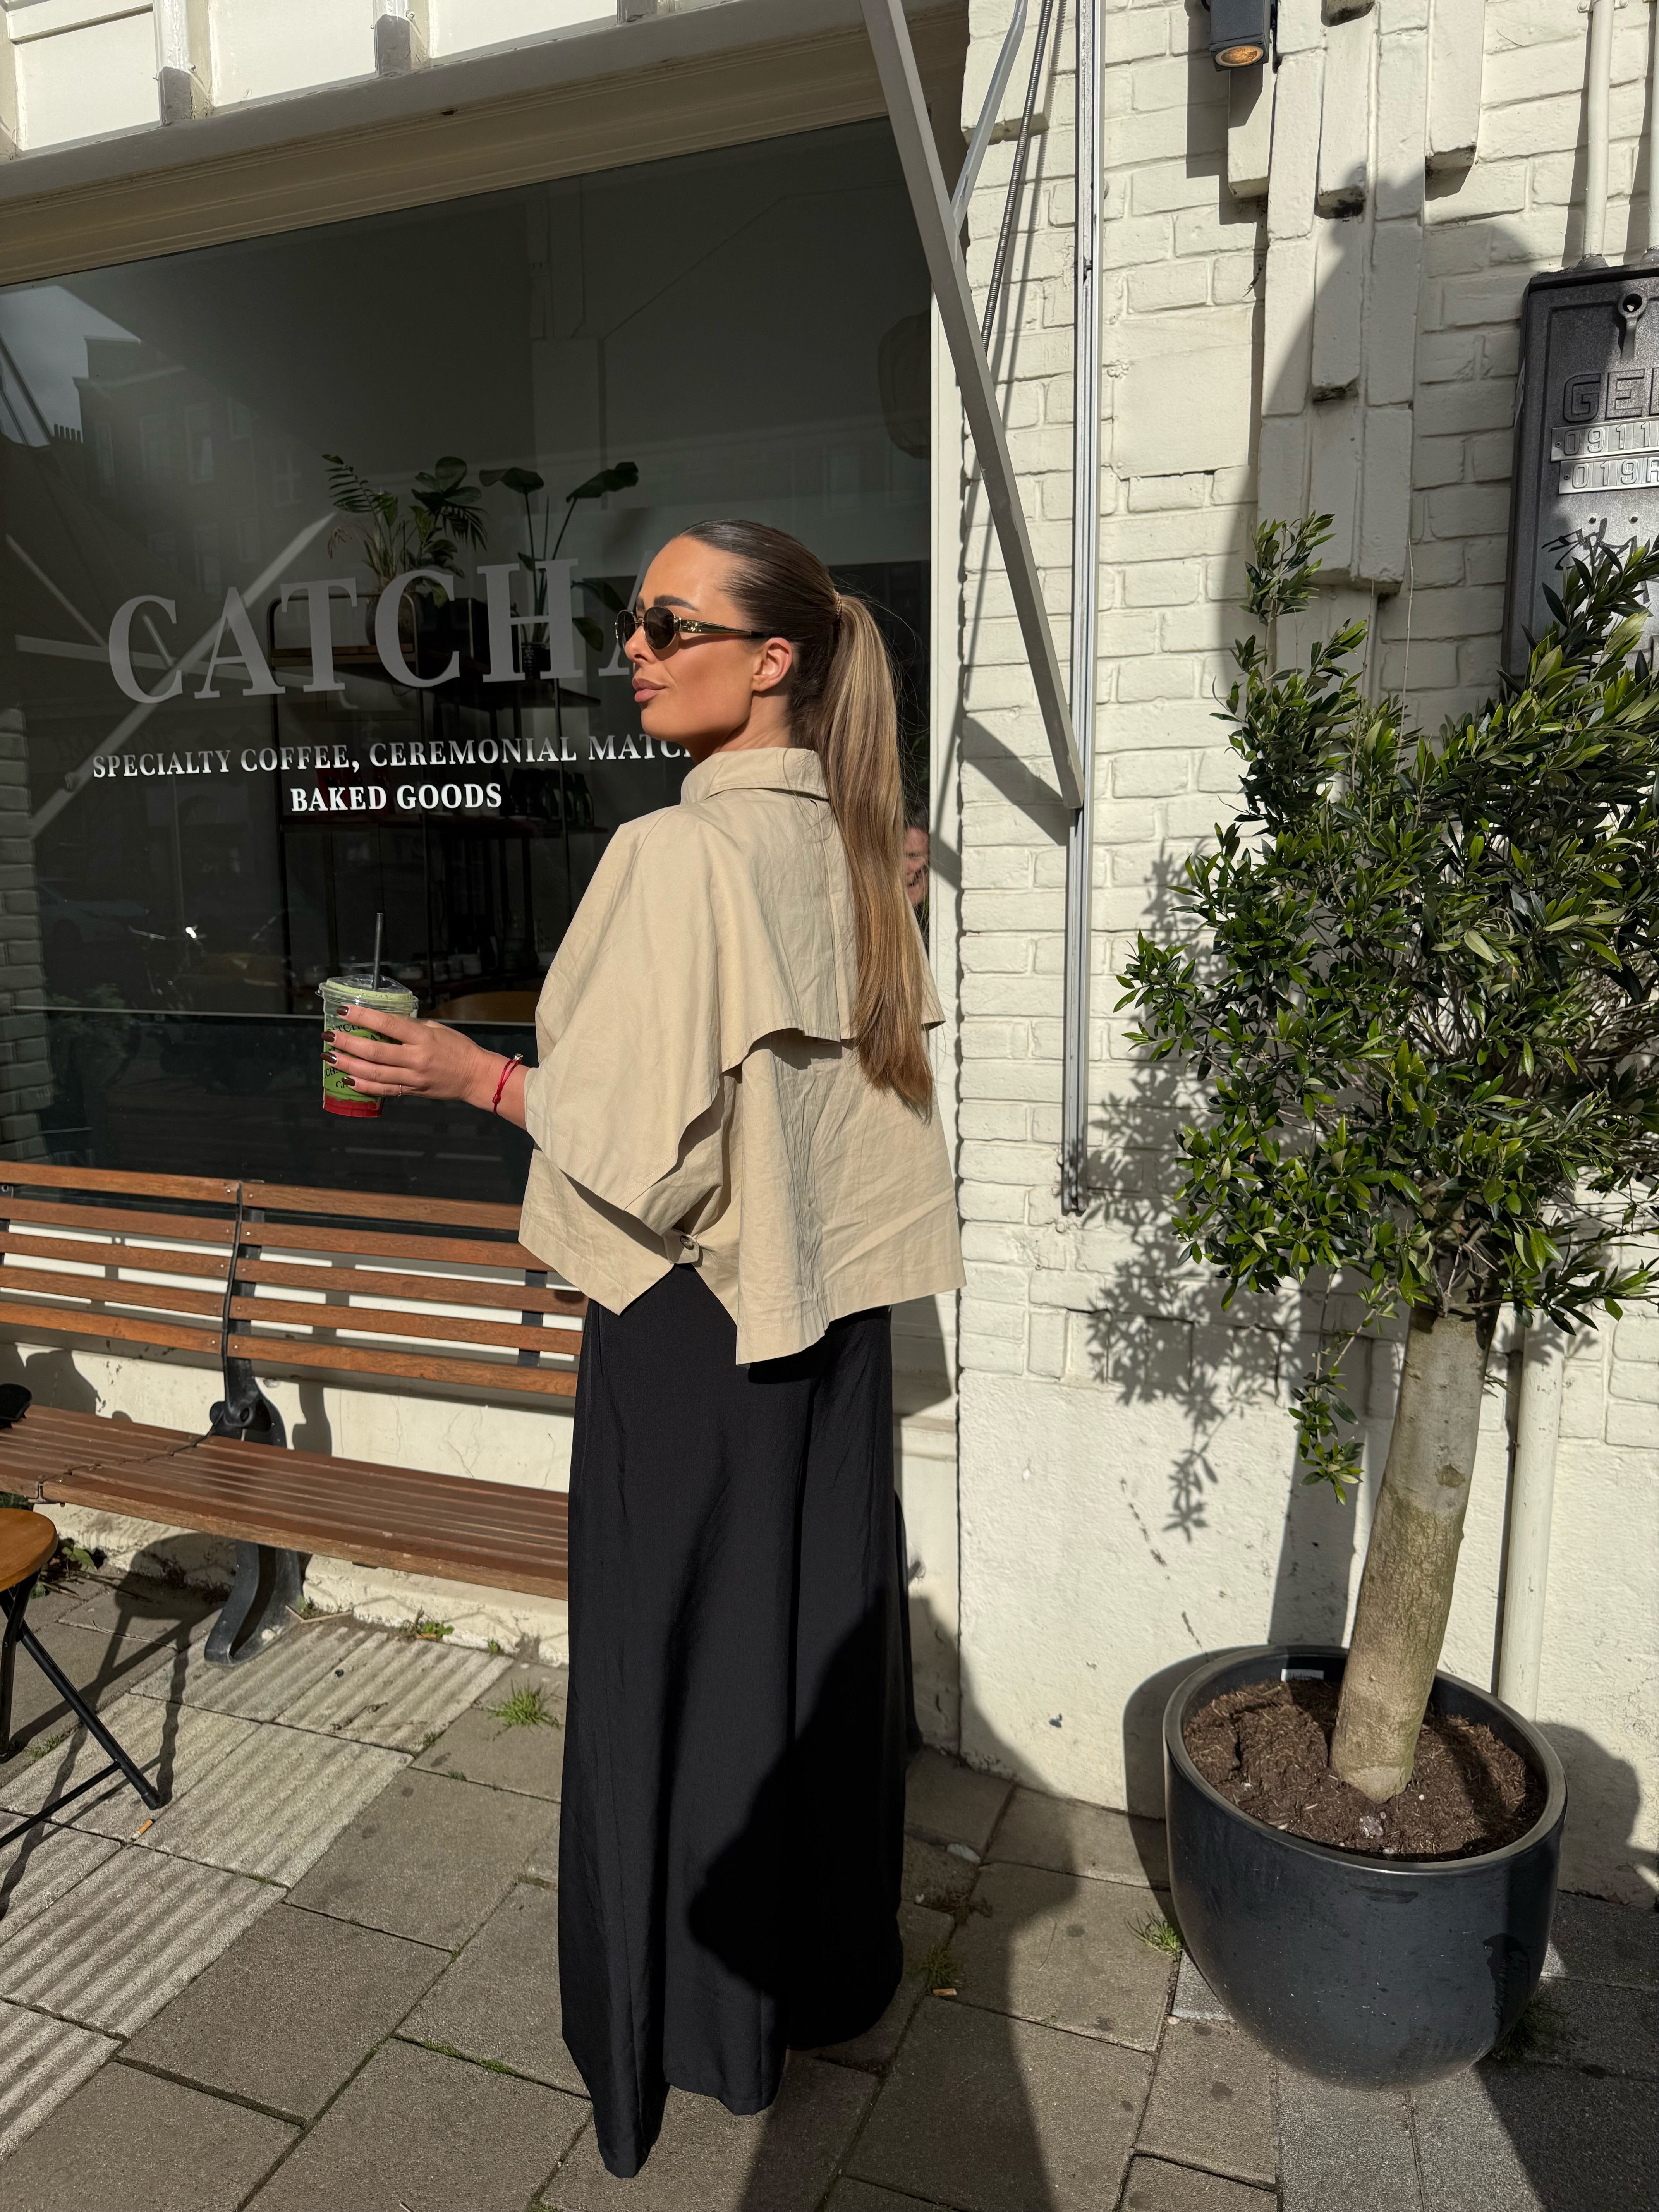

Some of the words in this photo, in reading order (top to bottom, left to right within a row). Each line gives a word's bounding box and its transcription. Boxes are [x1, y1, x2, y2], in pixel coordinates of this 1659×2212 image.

[1563, 367, 1659, 423] GE
[93, 750, 231, 778] SPECIALTY
[240, 744, 360, 773] COFFEE,
[369, 737, 577, 768] CEREMONIAL
[588, 733, 691, 761] MATC
[290, 785, 387, 812] BAKED
[397, 782, 502, 810] GOODS
